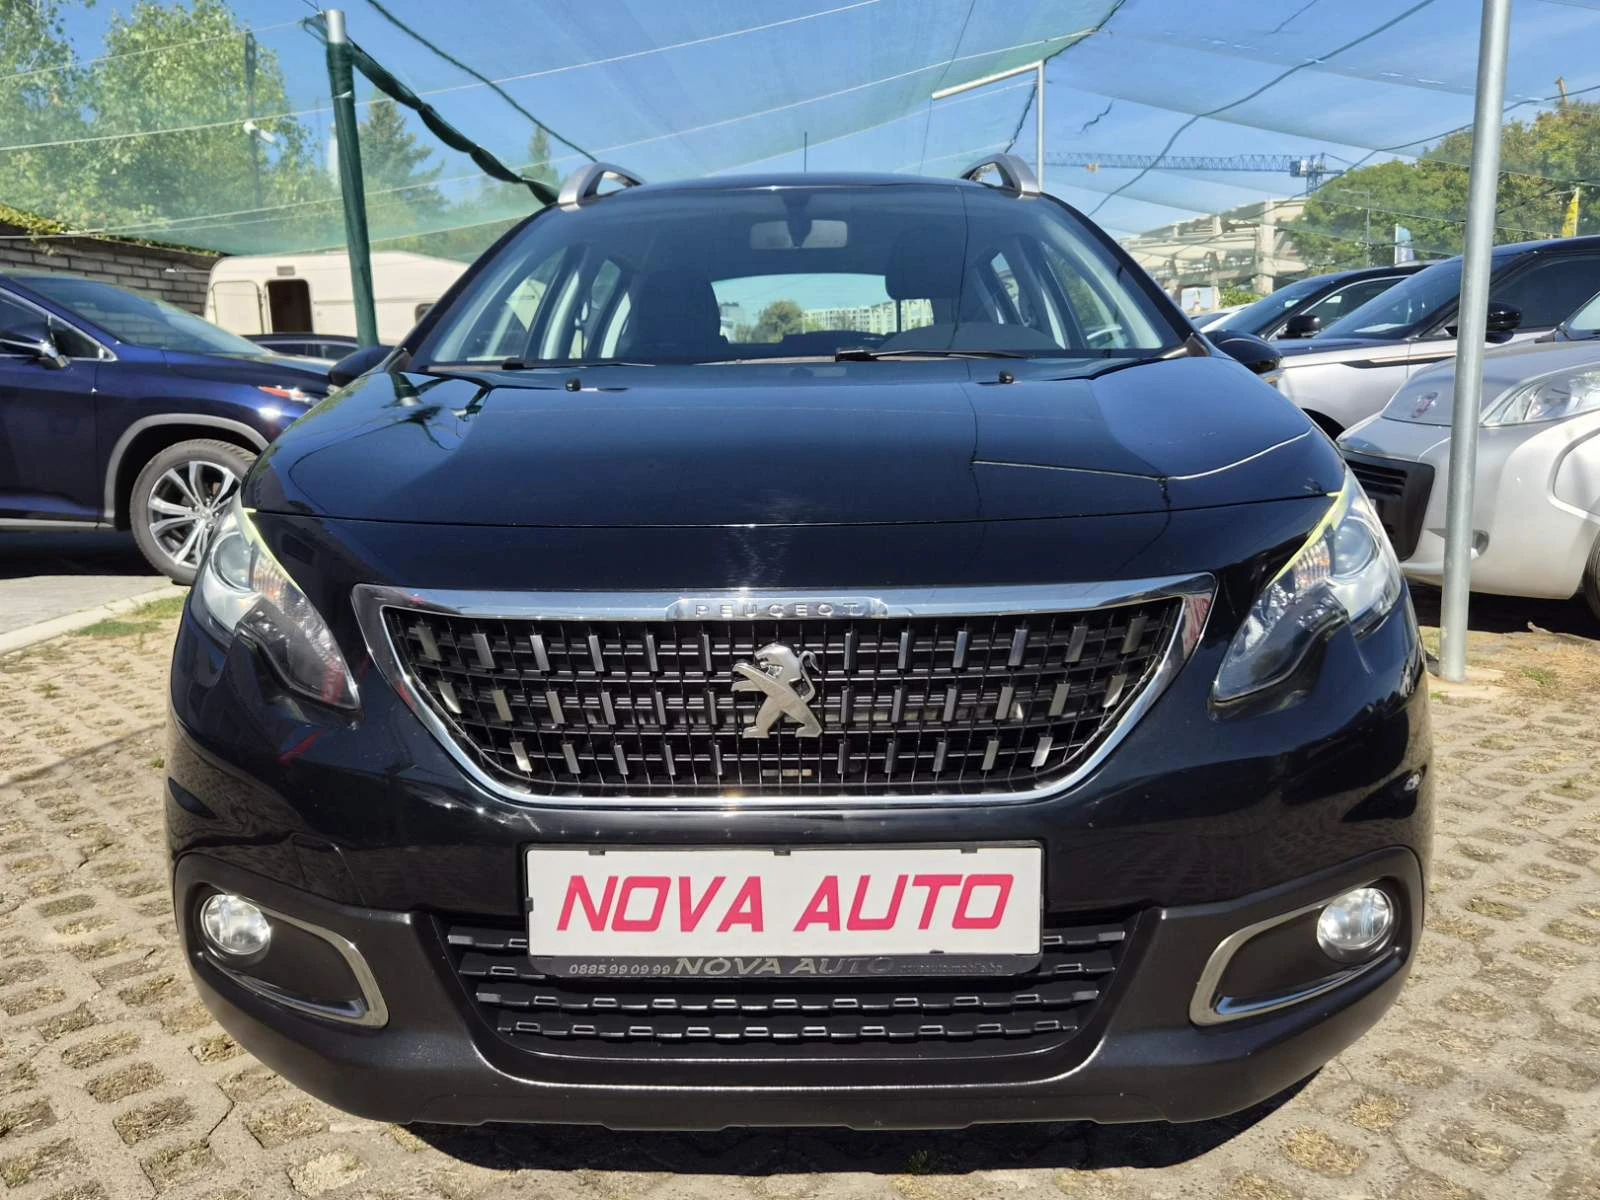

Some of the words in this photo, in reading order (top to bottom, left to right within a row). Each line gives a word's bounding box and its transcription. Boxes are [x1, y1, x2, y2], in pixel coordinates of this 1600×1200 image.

[695, 603, 865, 618] PEUGEOT
[556, 875, 764, 932] NOVA
[793, 874, 1015, 932] AUTO
[673, 957, 781, 975] NOVA
[789, 956, 893, 975] AUTO
